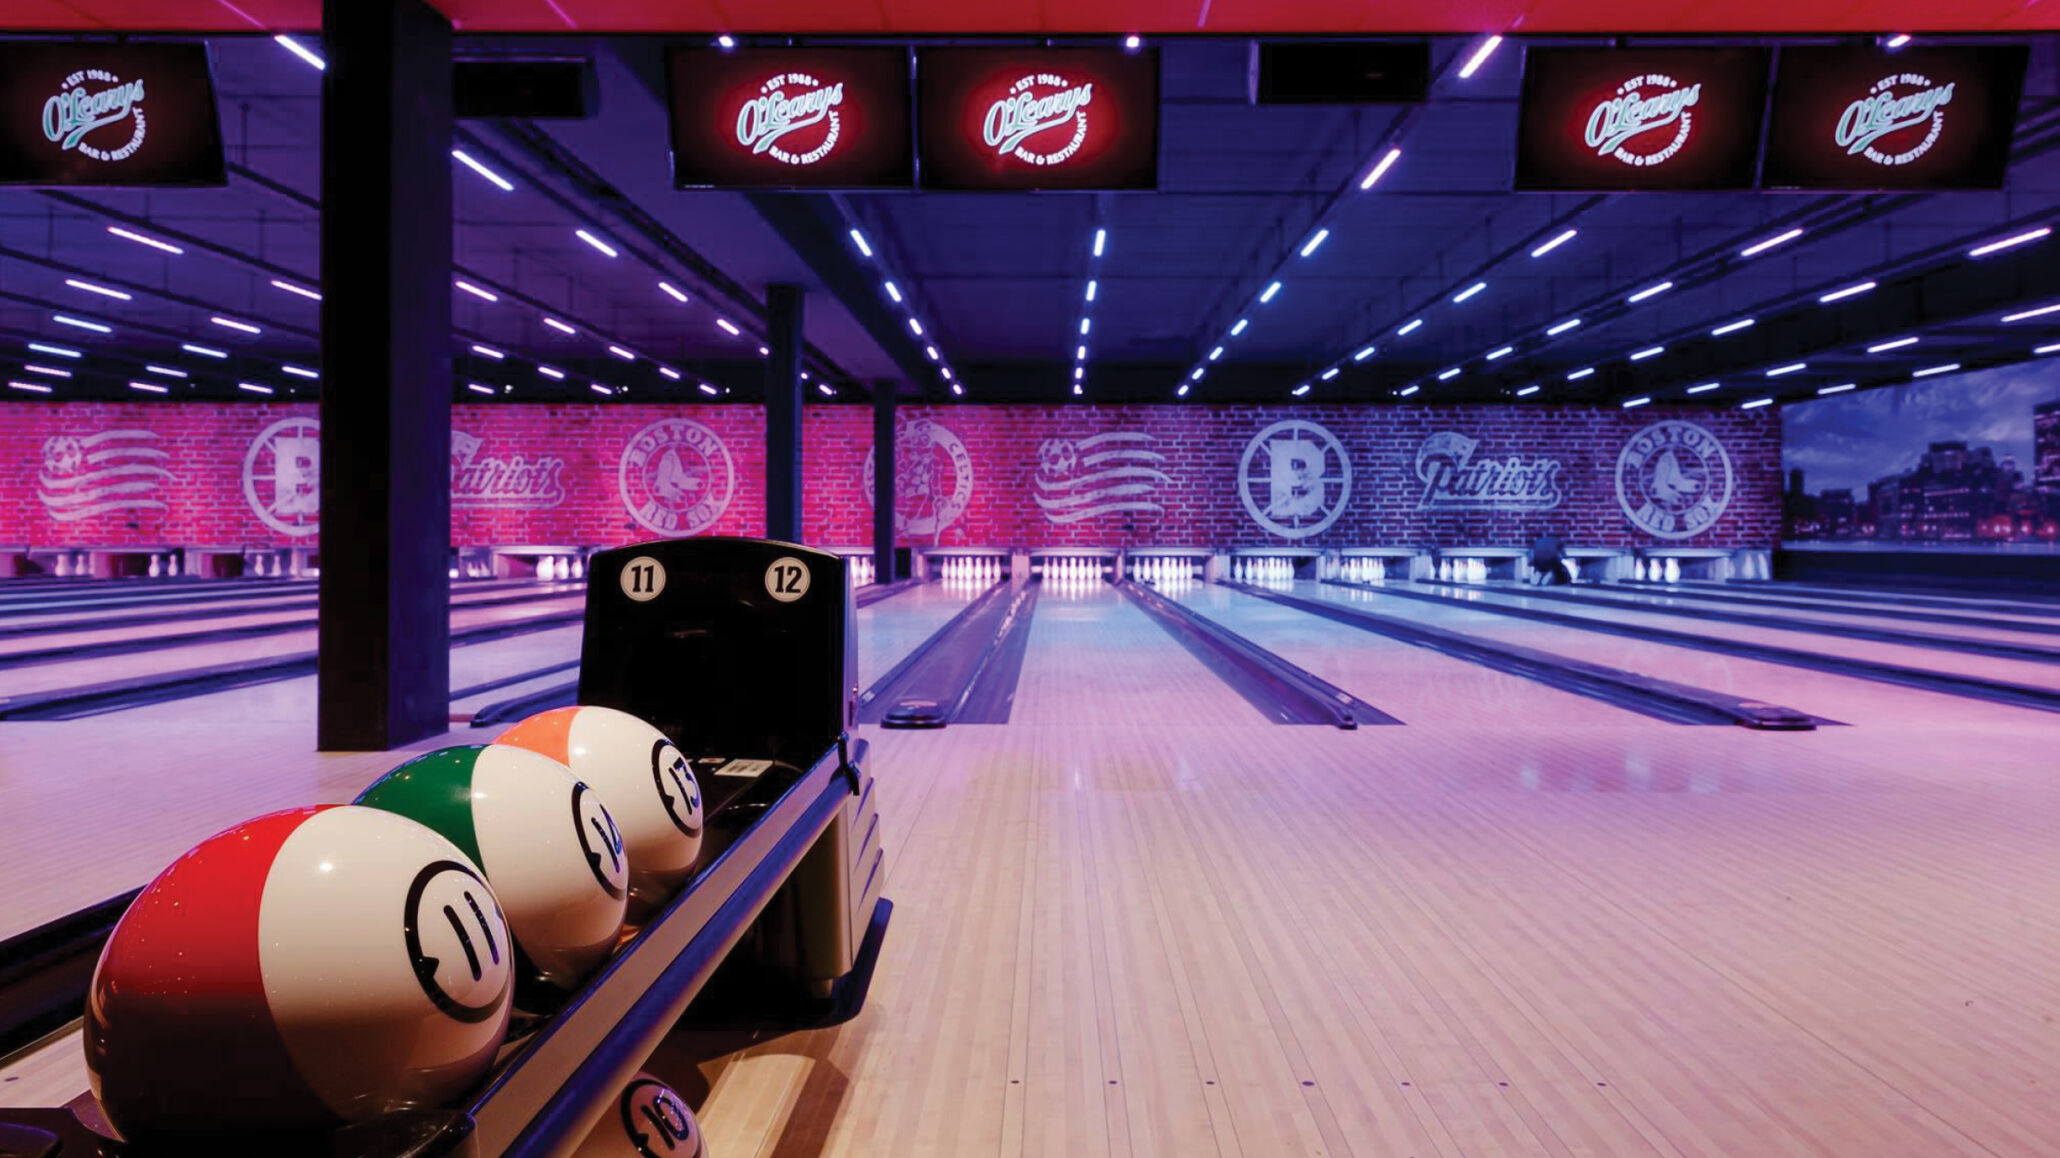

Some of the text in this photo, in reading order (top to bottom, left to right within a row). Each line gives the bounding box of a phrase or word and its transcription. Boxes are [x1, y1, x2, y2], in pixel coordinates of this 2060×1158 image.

[766, 74, 785, 91] EST
[1015, 75, 1034, 91] EST
[768, 110, 840, 164] BAR & RESTAURANT
[1014, 111, 1087, 165] BAR & RESTAURANT
[630, 424, 720, 467] BOSTON
[1626, 427, 1716, 469] BOSTON
[451, 456, 565, 507] atriots
[949, 443, 968, 509] CELTICS
[1269, 440, 1325, 516] B
[1418, 457, 1560, 508] Patriots
[640, 493, 728, 530] RED SOX
[1636, 494, 1724, 532] RED SOX
[631, 564, 655, 593] 11
[773, 565, 803, 593] 12
[668, 756, 700, 815] 13
[443, 890, 500, 982] 11
[641, 1092, 690, 1151] 10
